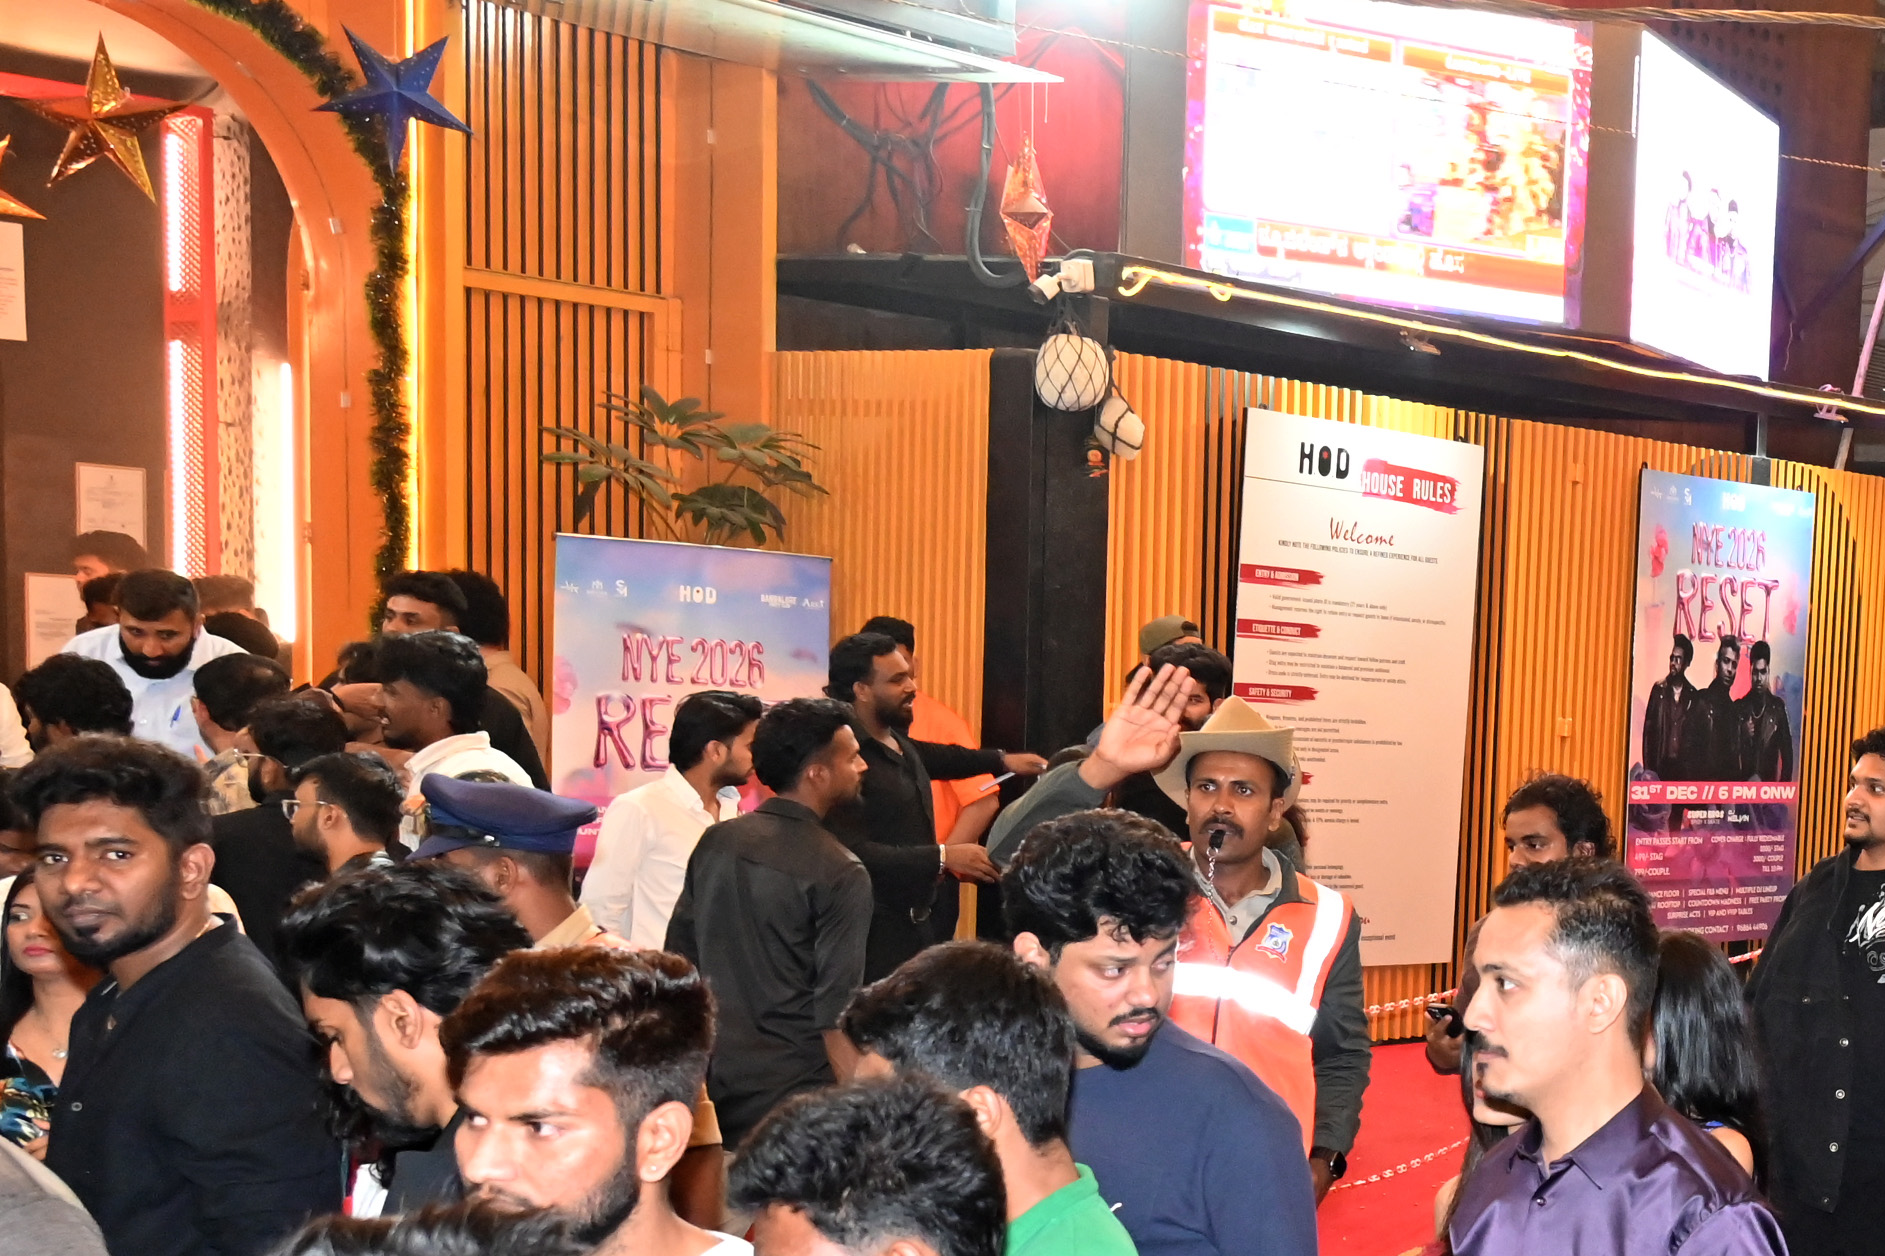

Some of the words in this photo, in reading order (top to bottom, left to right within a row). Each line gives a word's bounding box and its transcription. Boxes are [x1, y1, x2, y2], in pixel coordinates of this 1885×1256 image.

[1361, 470, 1404, 497] HOUSE
[1412, 478, 1452, 504] RULES
[1329, 516, 1395, 547] Welcome
[1691, 521, 1725, 568] NYE
[1727, 526, 1766, 572] 2026
[679, 585, 717, 604] HOD
[1673, 568, 1780, 644] RESET
[622, 633, 684, 685] NYE
[690, 638, 765, 689] 2026
[1249, 687, 1266, 697] SAFETY
[1270, 689, 1292, 698] SECURITY
[1666, 786, 1698, 800] DEC
[1718, 786, 1728, 800] 6
[1732, 786, 1756, 800] PM
[1760, 786, 1795, 800] ONW
[1635, 837, 1652, 846] ENTRY
[1652, 837, 1671, 845] PASSES
[1672, 836, 1687, 845] START
[1688, 836, 1703, 844] FROM
